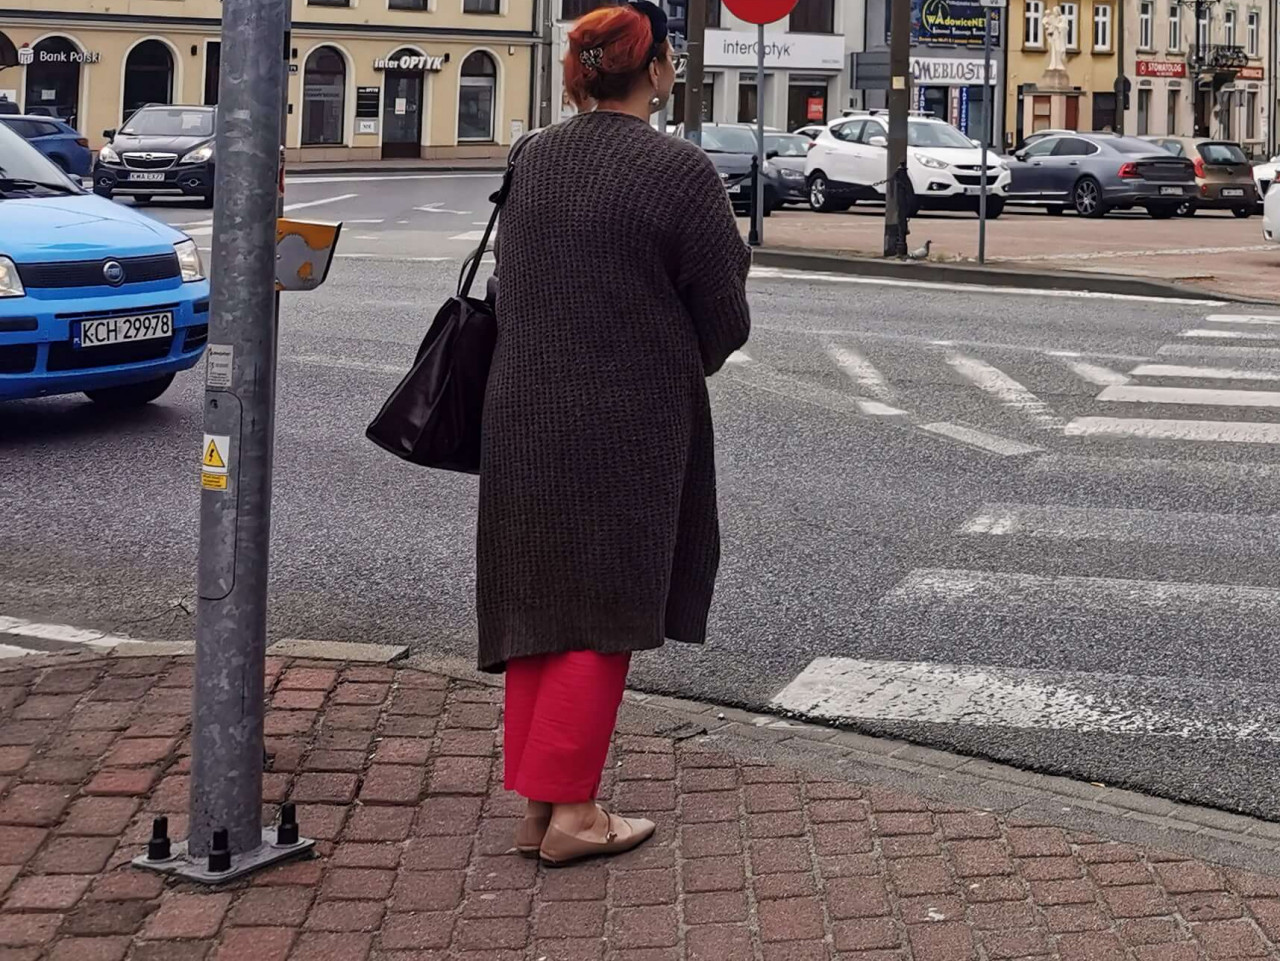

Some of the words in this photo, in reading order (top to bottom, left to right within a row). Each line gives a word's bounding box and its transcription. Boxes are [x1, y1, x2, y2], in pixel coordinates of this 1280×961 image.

[40, 50, 67, 62] Bank
[70, 51, 101, 63] Polski
[399, 55, 443, 70] OPTYK
[913, 59, 997, 81] MEBLOSTL
[1148, 62, 1182, 72] STOMATOLOG
[83, 320, 118, 344] KCH
[122, 314, 170, 339] 29978
